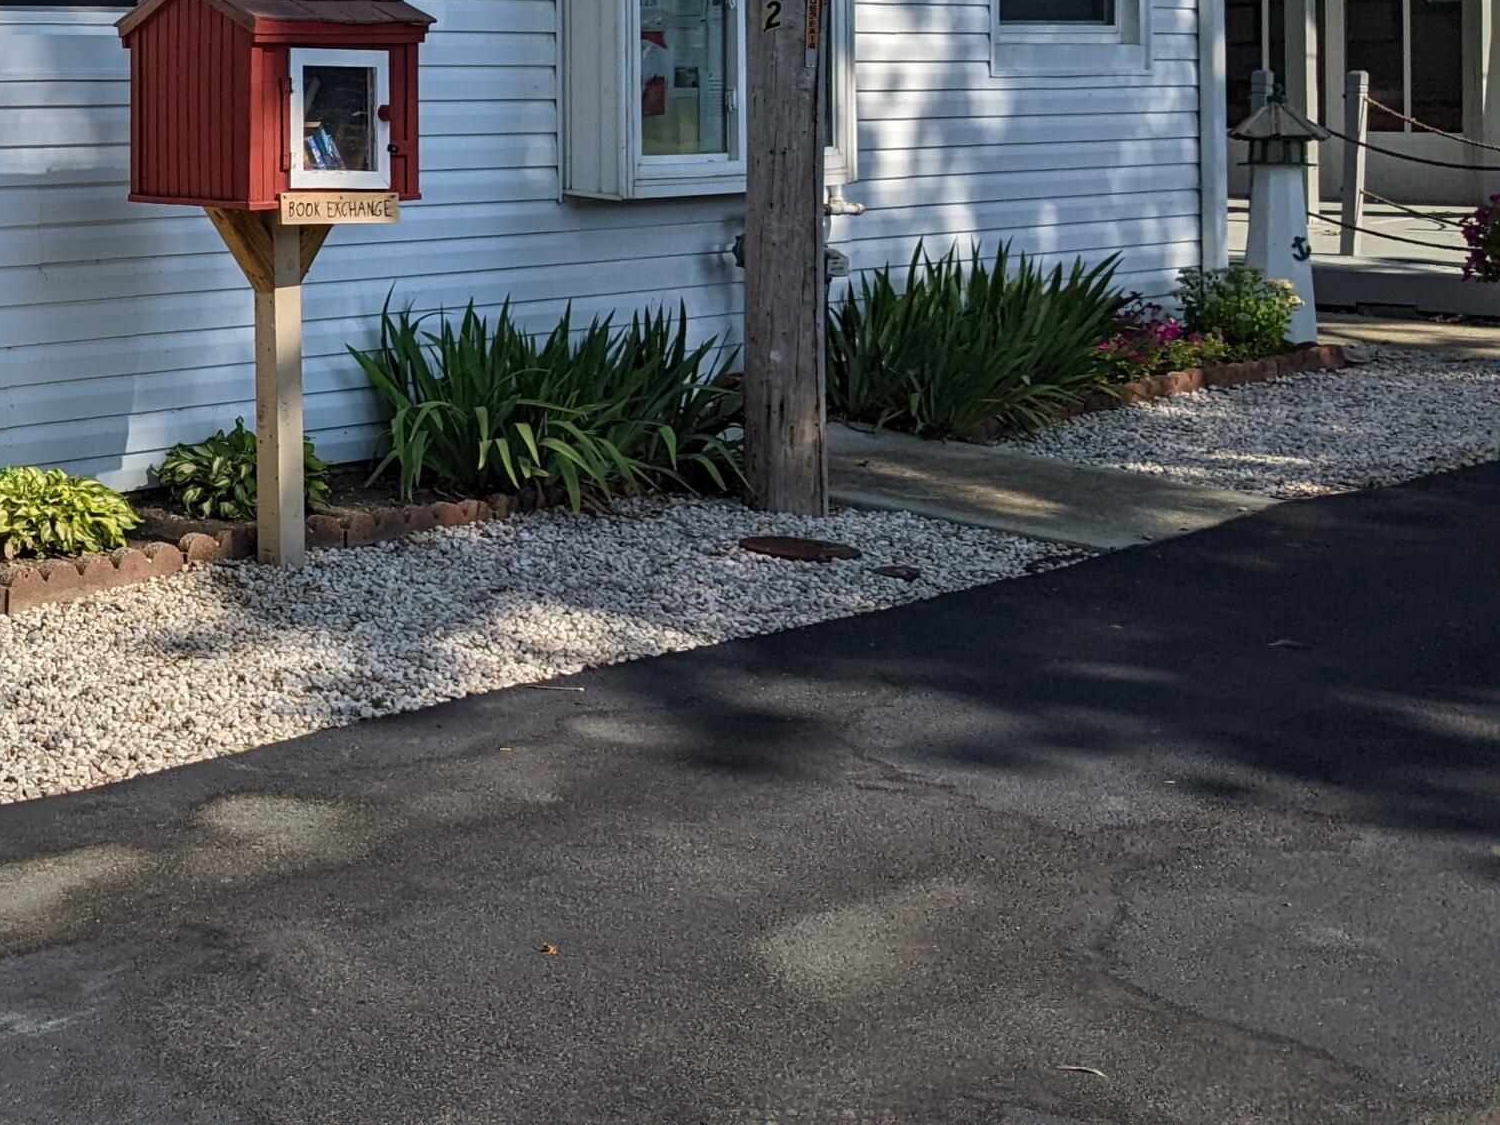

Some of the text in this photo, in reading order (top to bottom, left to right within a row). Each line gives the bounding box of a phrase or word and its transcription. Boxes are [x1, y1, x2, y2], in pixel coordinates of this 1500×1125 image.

[764, 1, 781, 32] 2
[288, 200, 393, 218] BOOK EXCHANGE
